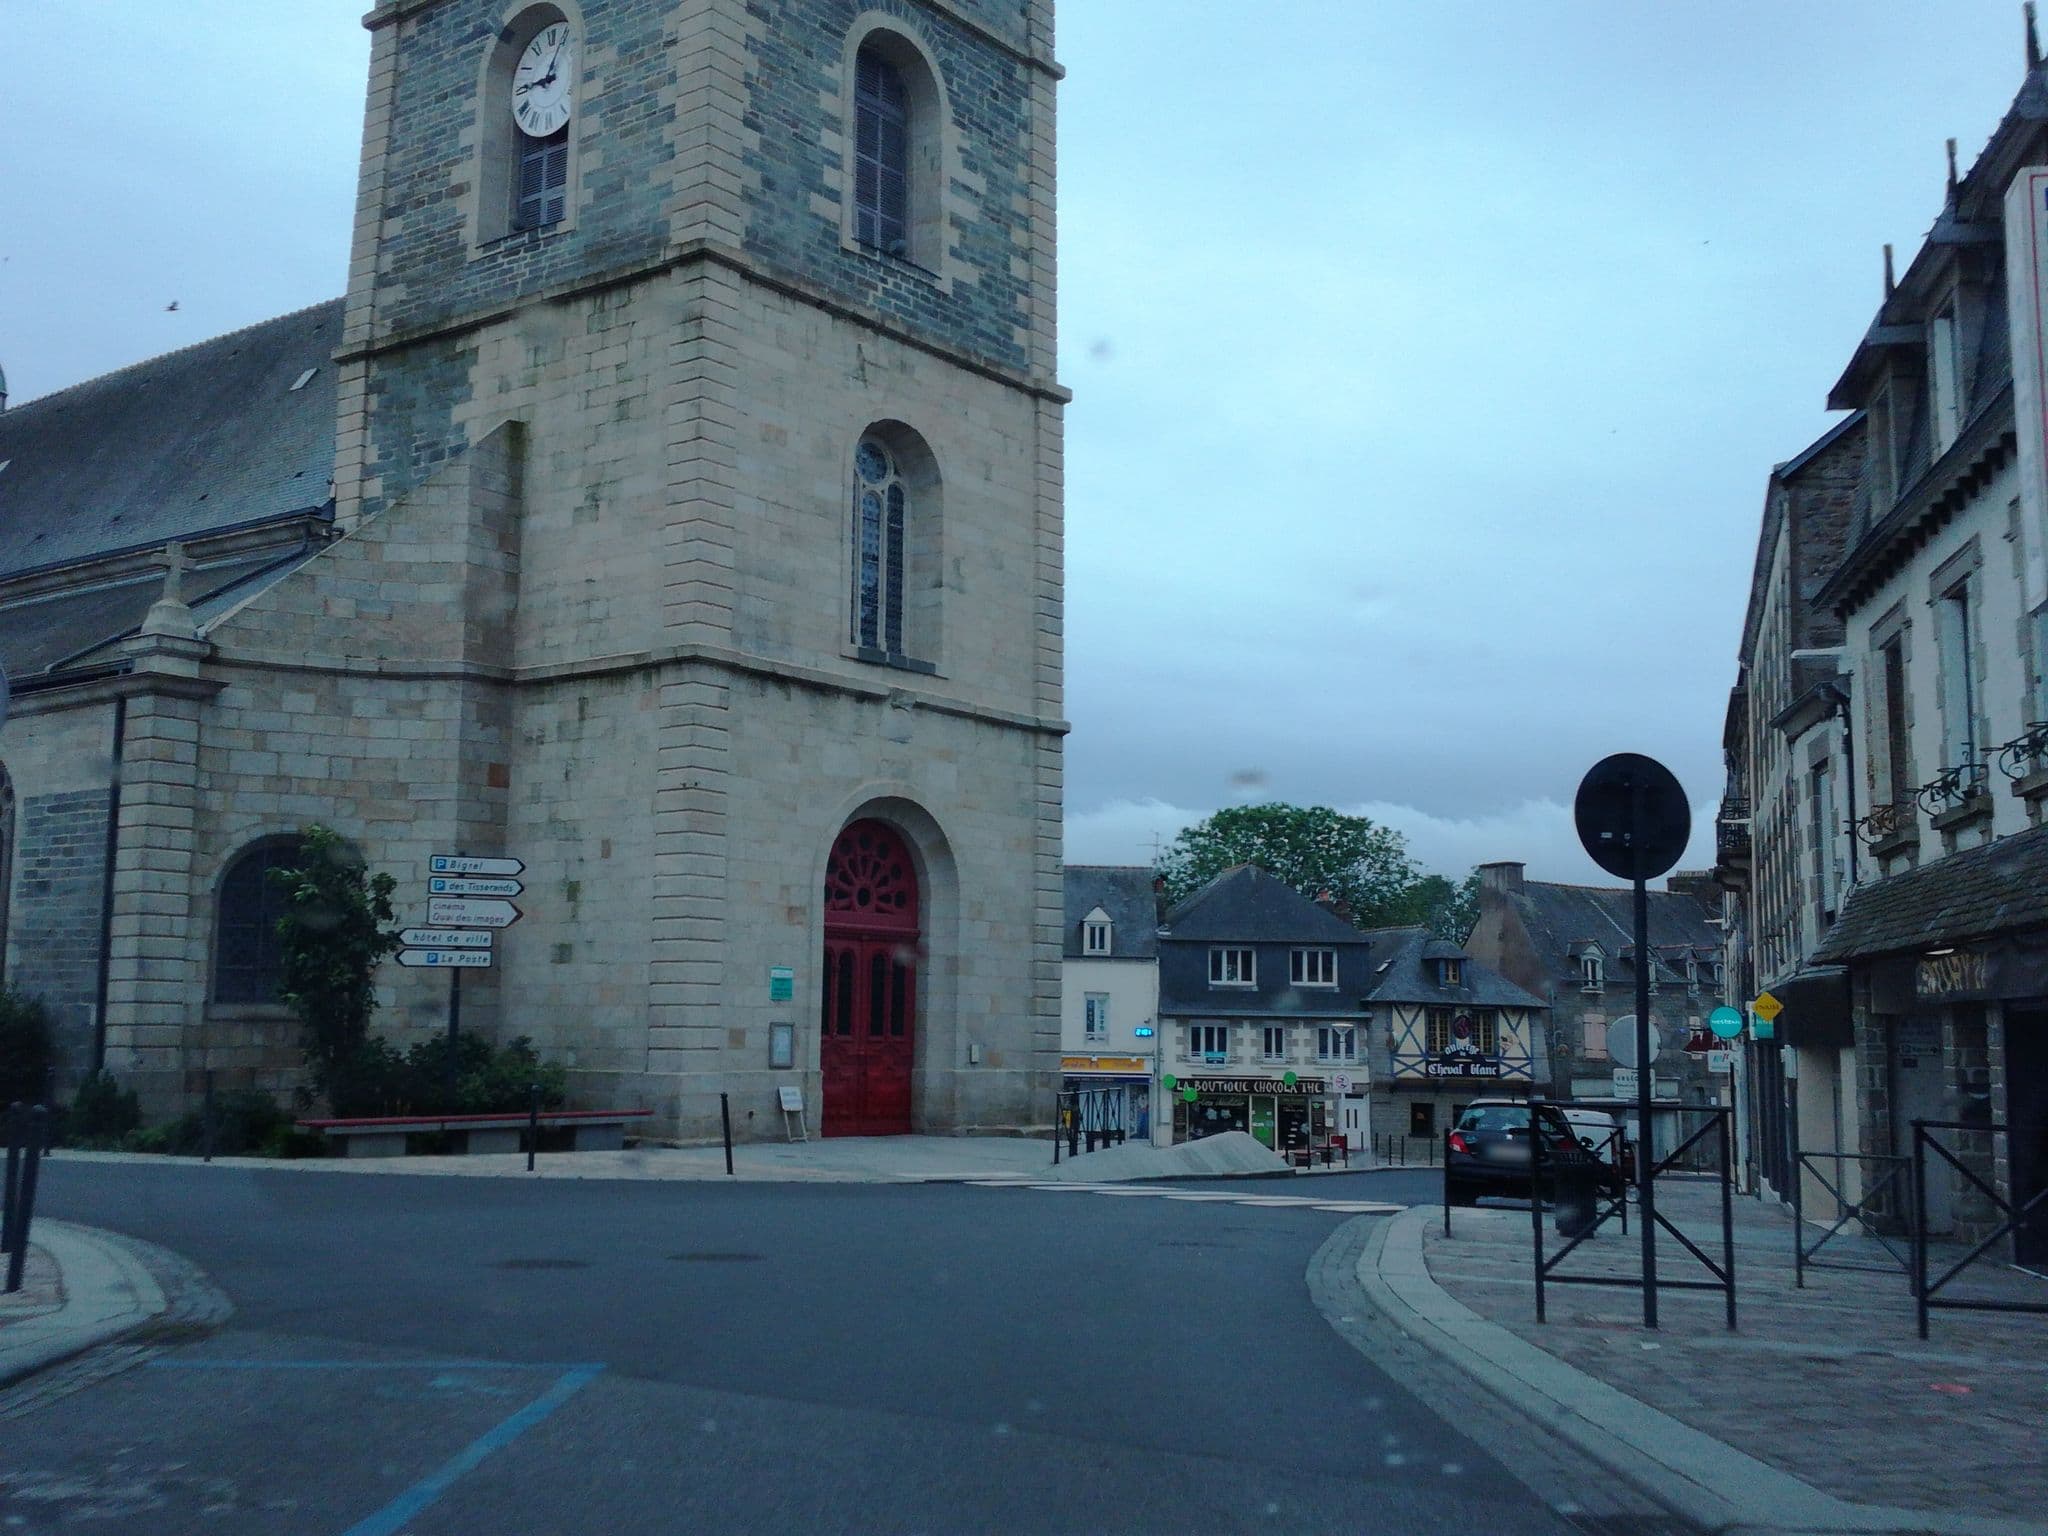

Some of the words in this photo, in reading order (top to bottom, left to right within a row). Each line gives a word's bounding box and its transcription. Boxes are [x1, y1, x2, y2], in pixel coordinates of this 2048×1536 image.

[448, 882, 464, 890] des
[468, 882, 514, 892] Tisserands
[446, 934, 459, 942] de
[465, 934, 489, 944] ville
[1428, 1063, 1464, 1076] Cheval
[1470, 1063, 1497, 1075] blanc
